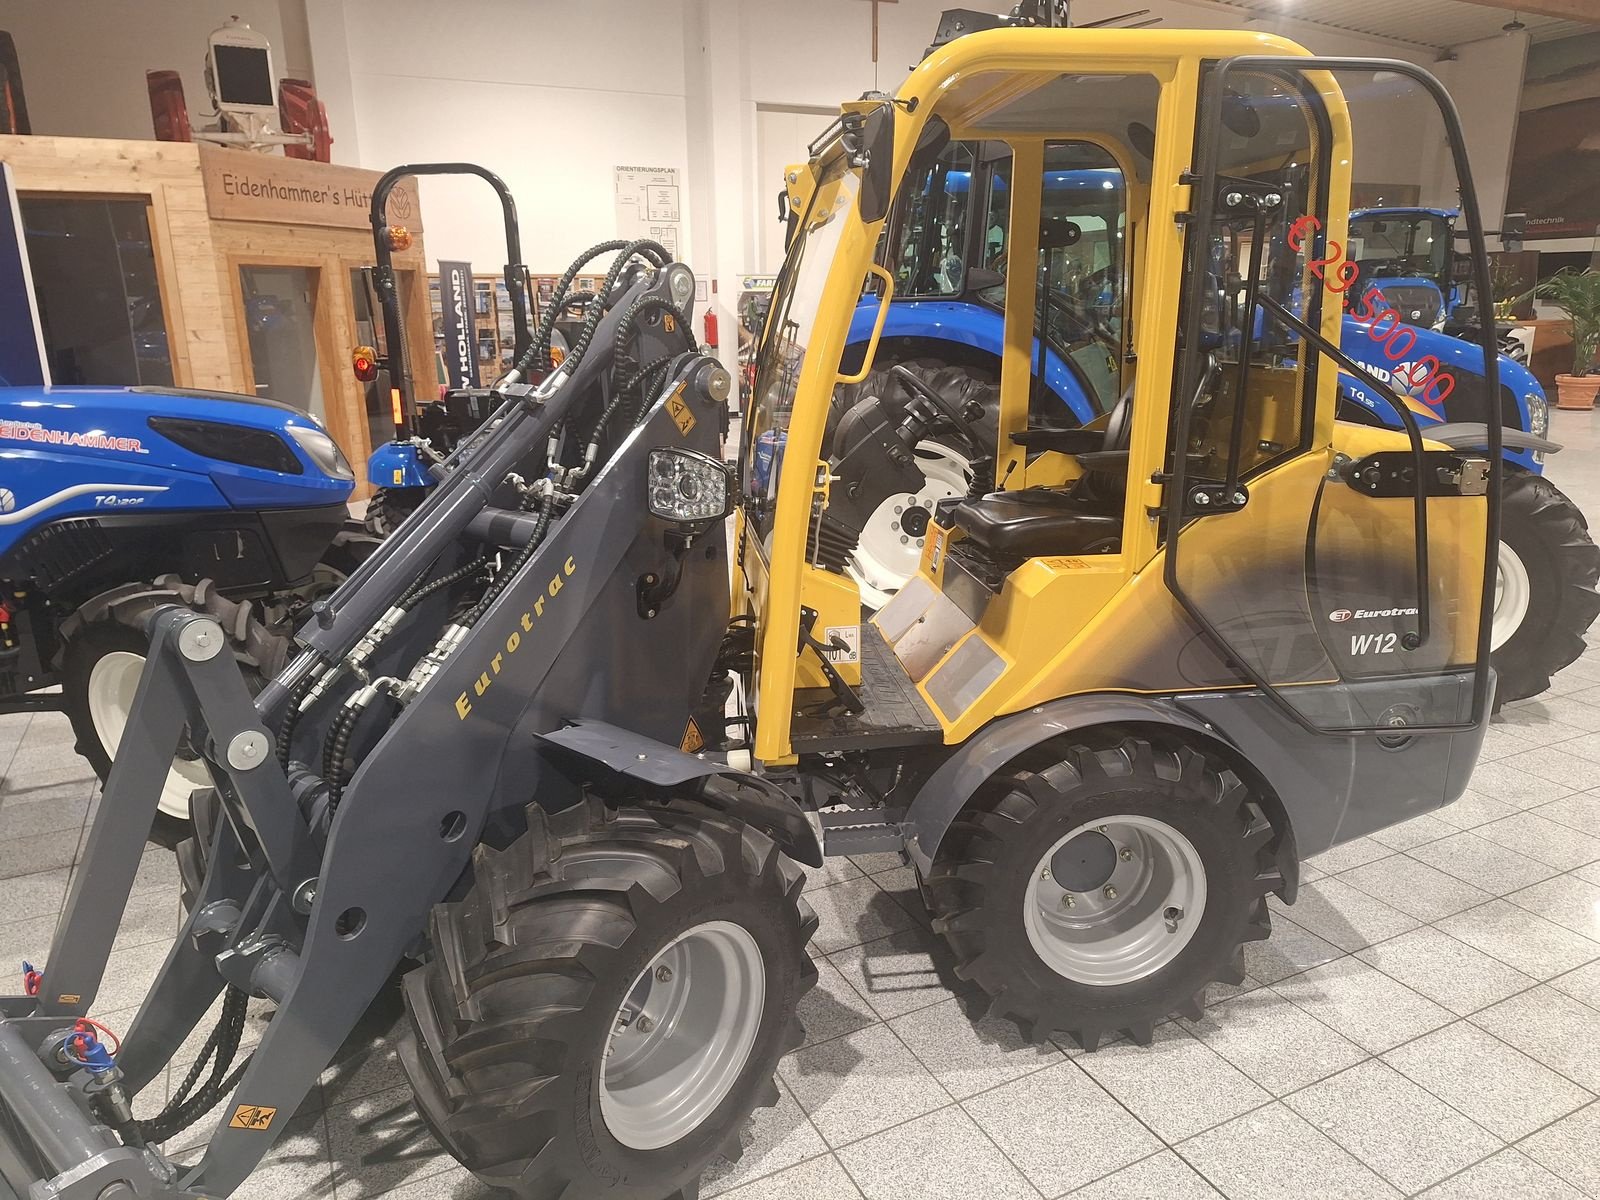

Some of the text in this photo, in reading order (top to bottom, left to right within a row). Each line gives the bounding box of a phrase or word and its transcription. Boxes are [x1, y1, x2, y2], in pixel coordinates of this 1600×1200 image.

[616, 165, 676, 174] ORIENTIERUNGSPLAN
[222, 173, 340, 205] Eidenhammer's
[451, 269, 469, 373] HOLLAND
[1287, 214, 1456, 406] € 29.500,00
[0, 425, 142, 452] EIDENHAMMER
[1354, 607, 1419, 619] Eurotra
[454, 555, 577, 721] Eurotrac
[1351, 632, 1398, 656] W12
